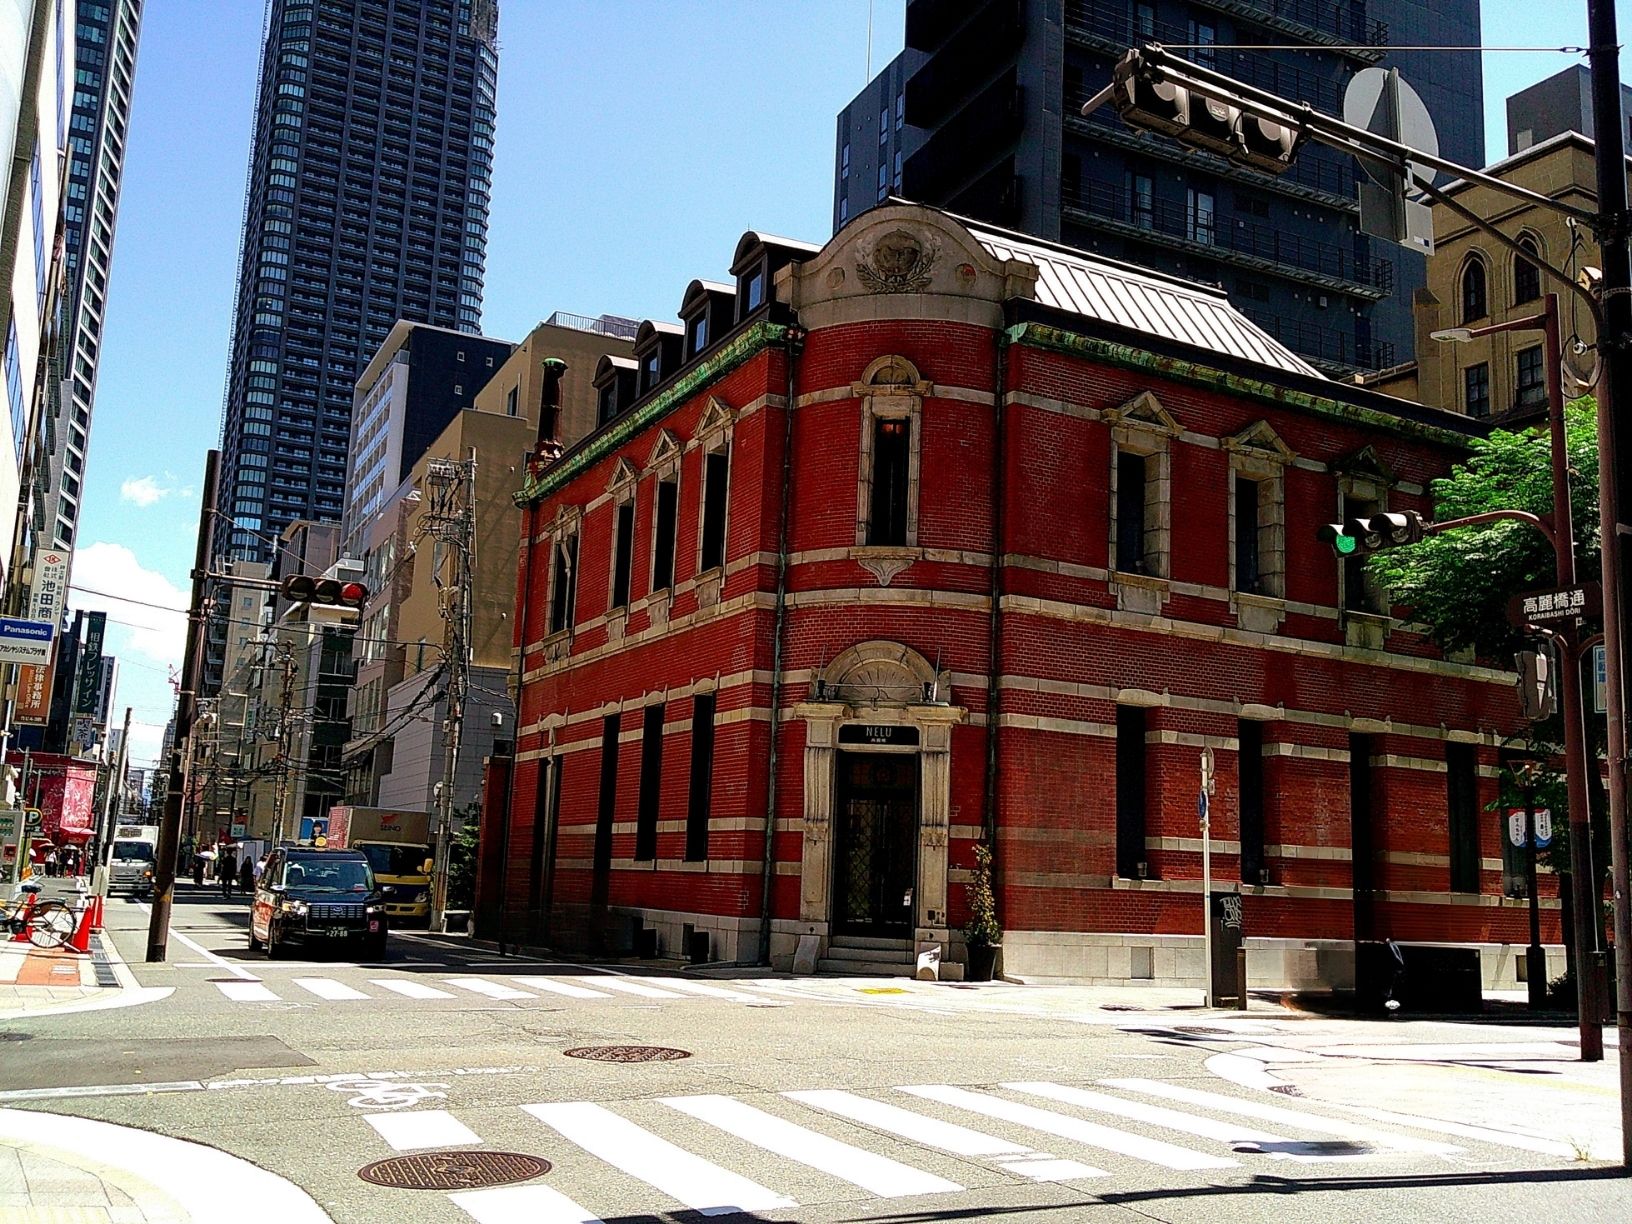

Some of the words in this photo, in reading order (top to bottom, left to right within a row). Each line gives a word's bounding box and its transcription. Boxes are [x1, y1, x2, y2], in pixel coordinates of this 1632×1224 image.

[38, 580, 56, 621] 池田商
[1523, 589, 1585, 614] 高麗橋通
[1528, 610, 1564, 621] KORAIBASHI
[4, 624, 48, 636] Panasonic
[866, 726, 892, 737] NELU
